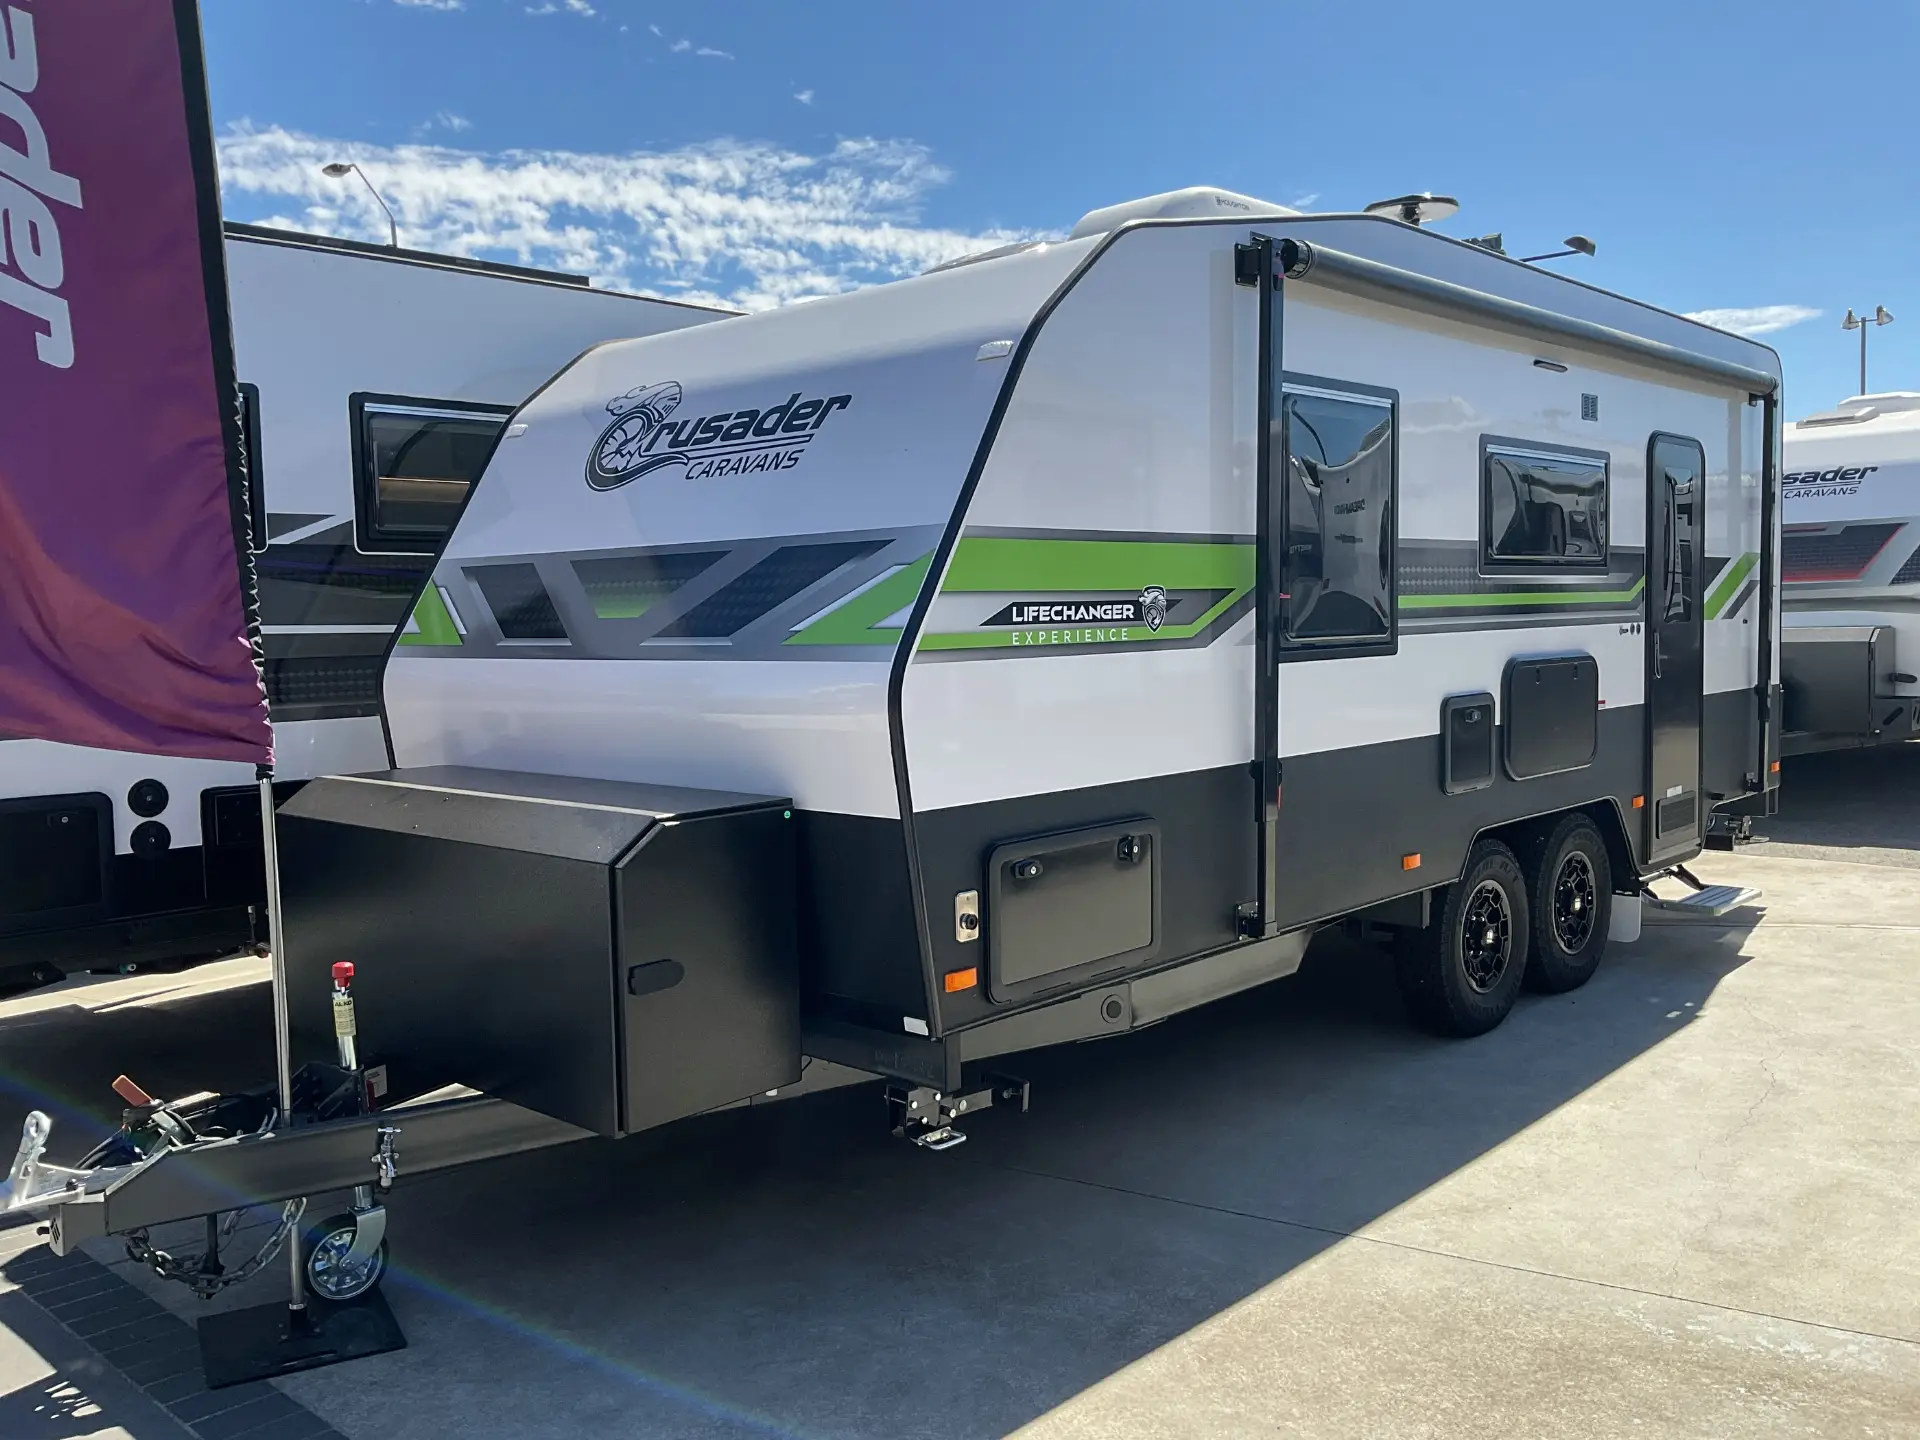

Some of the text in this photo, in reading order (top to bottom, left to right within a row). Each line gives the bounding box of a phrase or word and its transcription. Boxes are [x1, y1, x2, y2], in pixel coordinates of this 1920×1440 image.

[685, 449, 805, 480] CARAVANS
[1783, 466, 1879, 485] sader
[1784, 487, 1859, 499] CARAVANS
[1012, 604, 1134, 622] LIFECHANGER
[1012, 628, 1128, 645] EXPERIENCE
